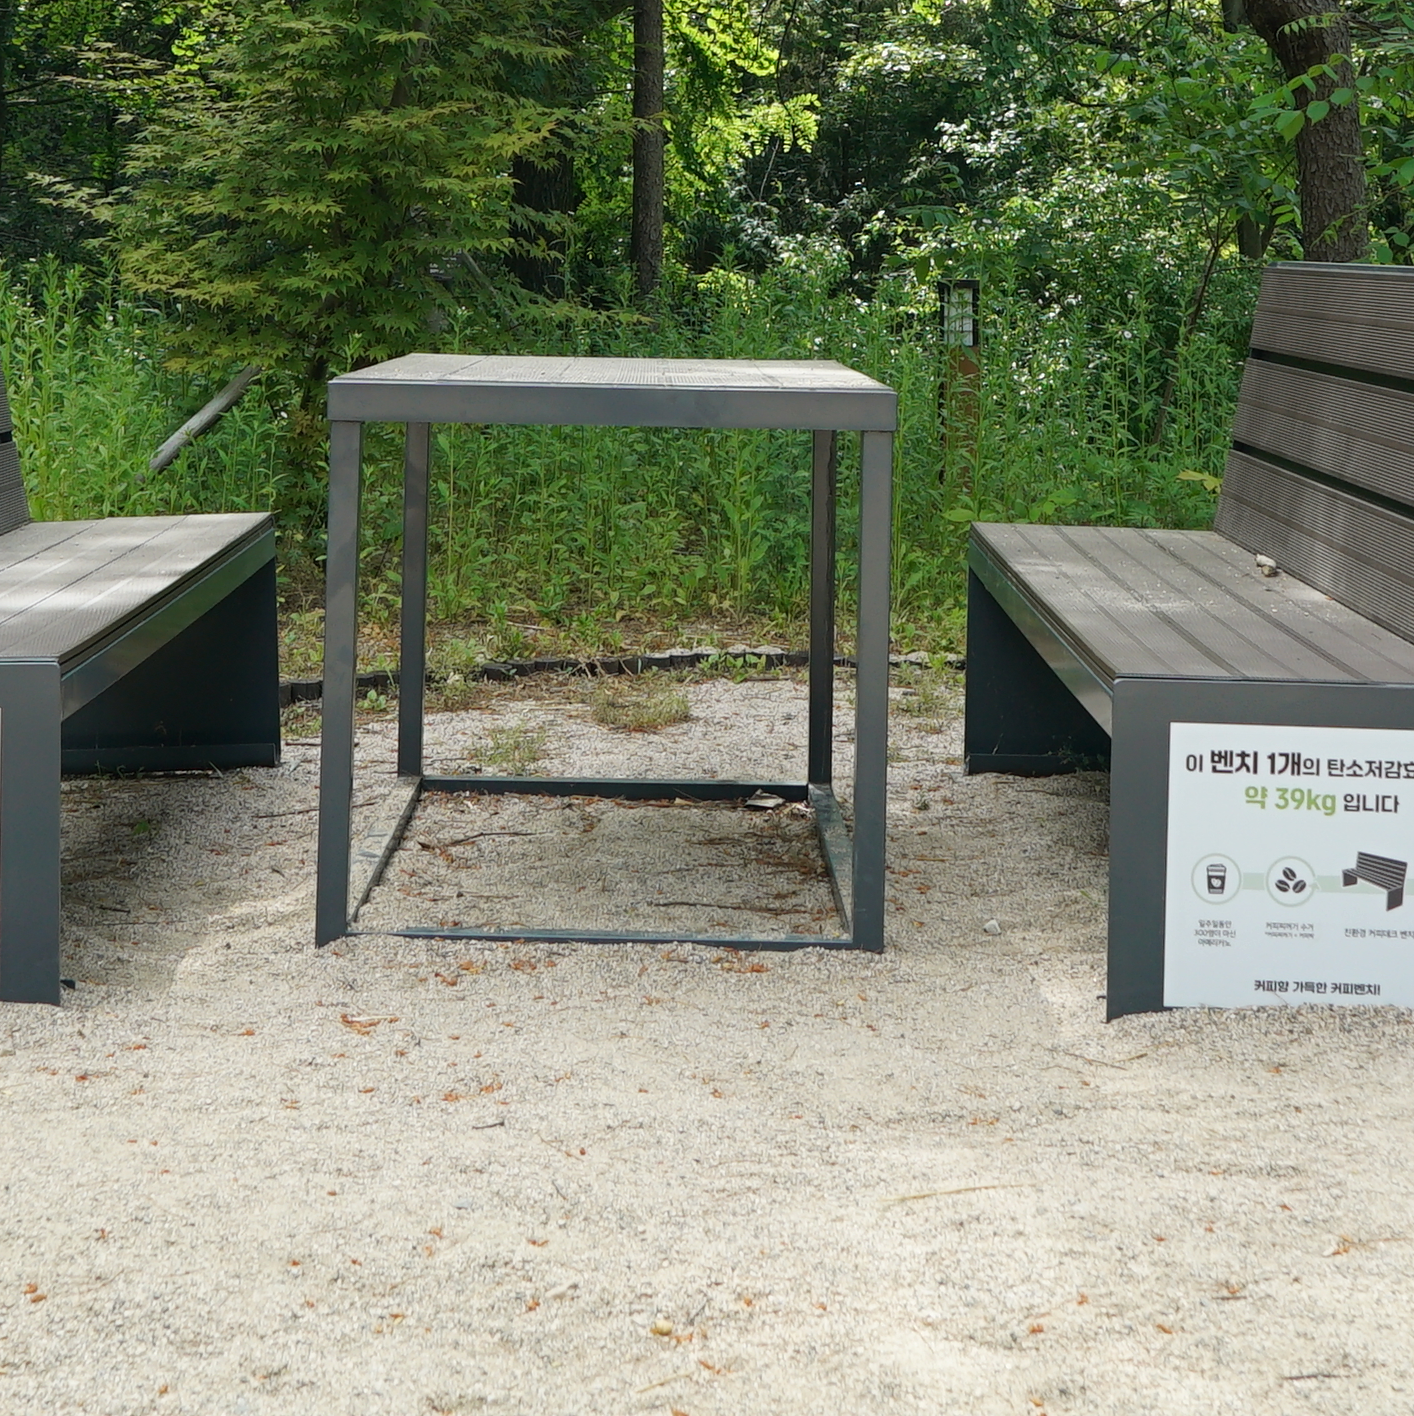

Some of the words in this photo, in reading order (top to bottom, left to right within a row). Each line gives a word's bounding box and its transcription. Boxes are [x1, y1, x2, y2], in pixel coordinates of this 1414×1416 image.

[1186, 755, 1203, 773] 이
[1210, 750, 1258, 774] 벤치
[1268, 752, 1320, 776] 1개의
[1245, 786, 1268, 809] 약
[1275, 788, 1336, 816] 39kg
[1343, 794, 1399, 813] 입니다
[1254, 979, 1289, 992] 커피향
[1293, 980, 1327, 994] 가득한
[1331, 982, 1380, 995] 커피벤치!
